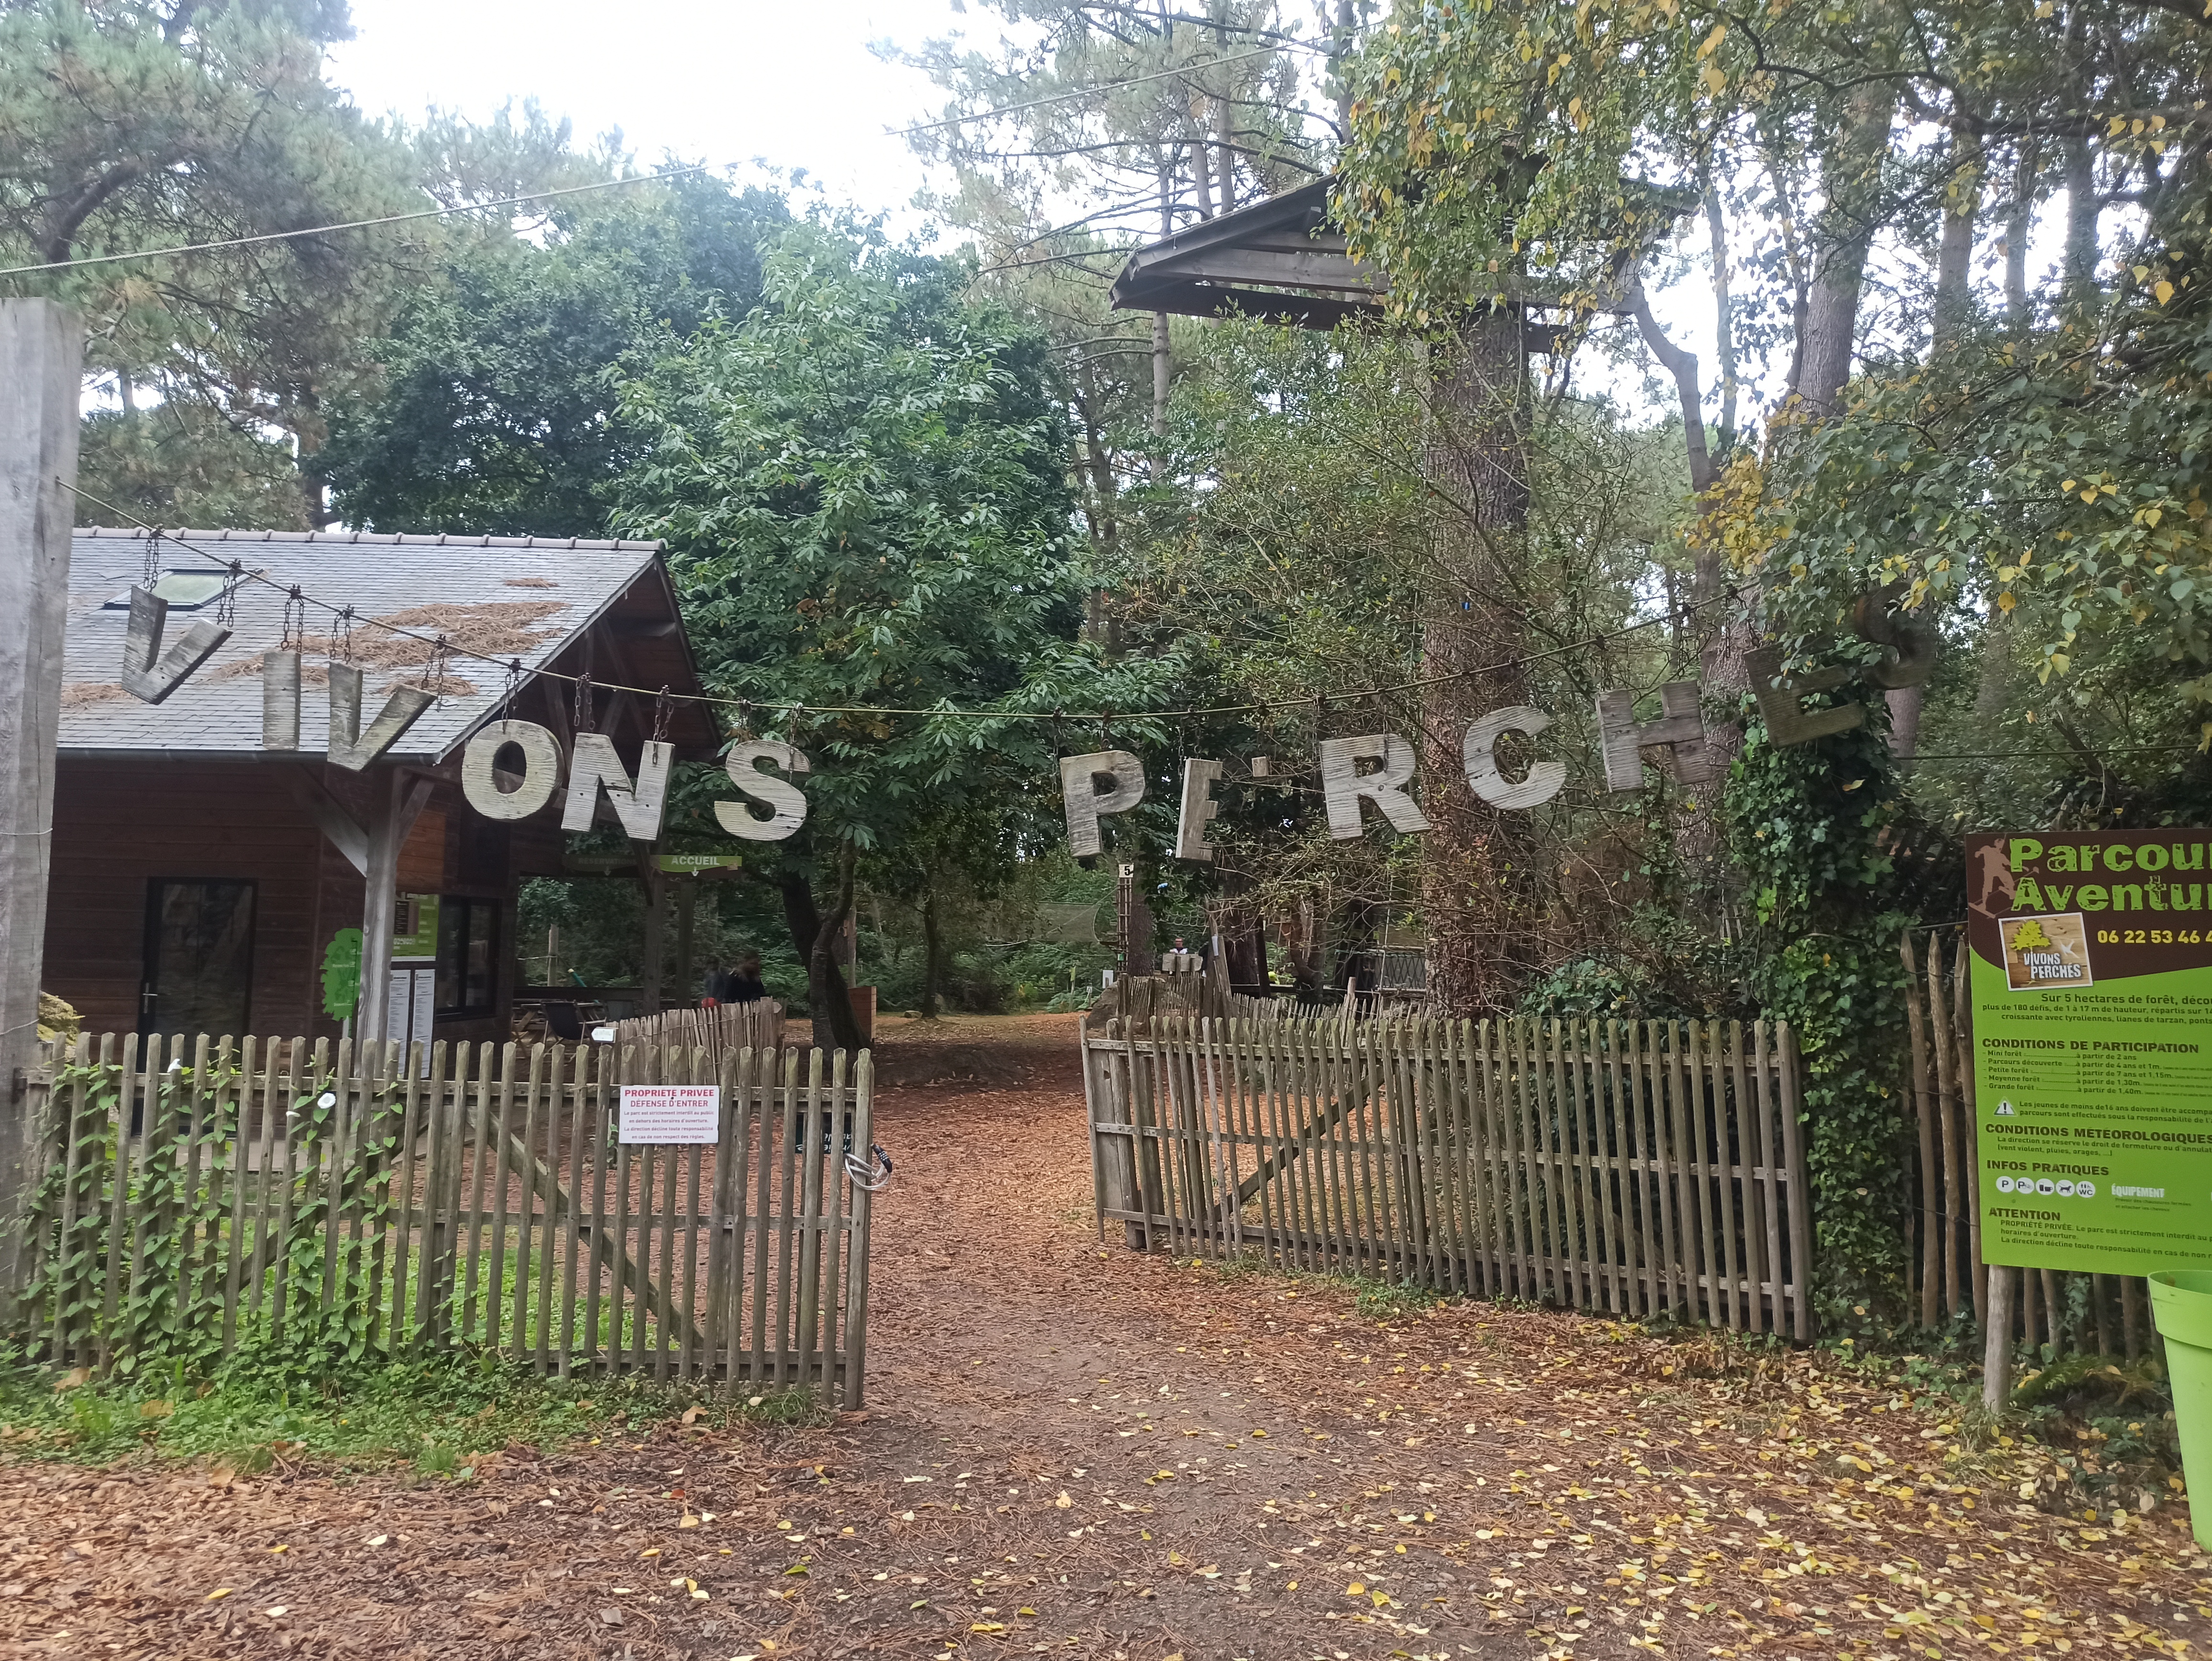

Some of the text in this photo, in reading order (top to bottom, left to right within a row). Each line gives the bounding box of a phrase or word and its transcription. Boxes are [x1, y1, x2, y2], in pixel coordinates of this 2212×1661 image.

[122, 585, 811, 841] VIVONS
[671, 856, 720, 865] ACCUEIL
[2010, 838, 2212, 872] Parcou
[1124, 866, 1130, 875] 5
[2011, 875, 2212, 911] Aventu
[2098, 930, 2119, 943] 06
[2124, 930, 2146, 943] 22
[2151, 930, 2173, 943] 53
[2178, 930, 2200, 943] 46
[2024, 952, 2061, 966] VIVONS
[2031, 963, 2081, 979] PERCHÉS
[2042, 993, 2061, 1002] Sur
[2065, 994, 2071, 1002] 5
[2075, 994, 2124, 1003] hectares
[2129, 995, 2142, 1003] de
[2146, 995, 2178, 1005] forêt,
[1982, 1038, 2199, 1053] CONDITIONS DE PARTICIPATION
[625, 1087, 714, 1097] PROPRIÉTÉ PRIVÉE
[630, 1098, 667, 1107] DÉFENSE
[2136, 1115, 2192, 1123] responsabilité
[1986, 1123, 2212, 1144] CONDITIONS MÉTÉOROLOGIQUES
[1987, 1160, 2109, 1175] INFOS PRATIQUES
[2111, 1183, 2165, 1198] ÉQUIPEMENT
[1989, 1207, 2060, 1220] ATTENTION
[2001, 1219, 2043, 1229] PROPRIÉTÉ
[2119, 1229, 2164, 1238] strictement
[2001, 1228, 2031, 1236] horaires
[2012, 1237, 2045, 1245] direction
[2046, 1240, 2072, 1248] décline
[2096, 1245, 2151, 1254] responsabilité
